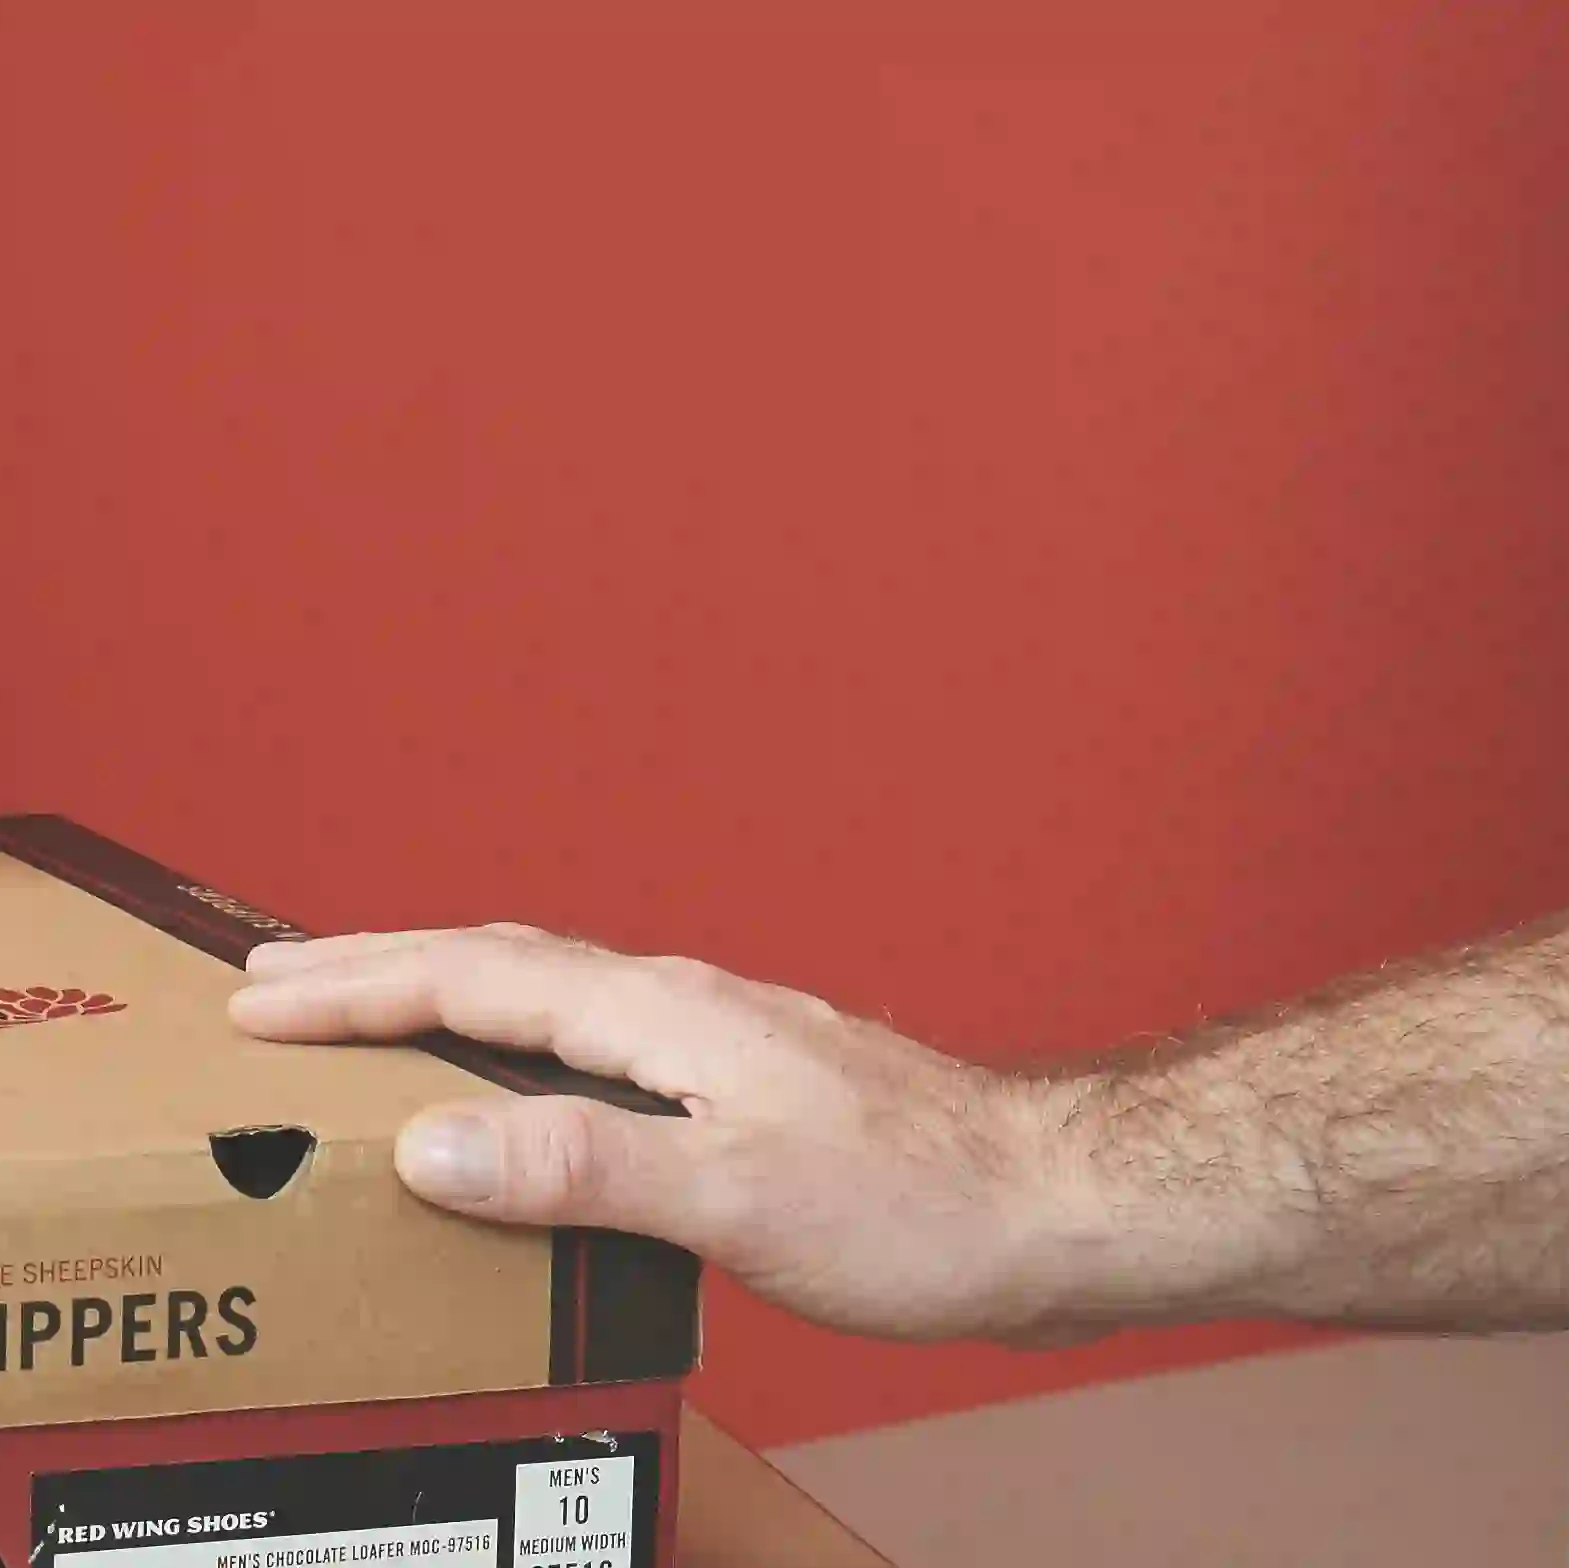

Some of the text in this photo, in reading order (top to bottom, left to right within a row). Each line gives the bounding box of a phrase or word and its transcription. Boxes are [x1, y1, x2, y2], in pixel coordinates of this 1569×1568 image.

[23, 1254, 163, 1285] SHEEPSKIN
[549, 1467, 600, 1487] MEN'S
[559, 1495, 589, 1526] 10
[58, 1511, 268, 1544] RED WING SHOES
[266, 1546, 348, 1568] CHOCOLATE
[352, 1541, 405, 1562] LOAFER
[409, 1534, 492, 1557] MOC-97516
[519, 1532, 626, 1556] MEDIUM WIDTH
